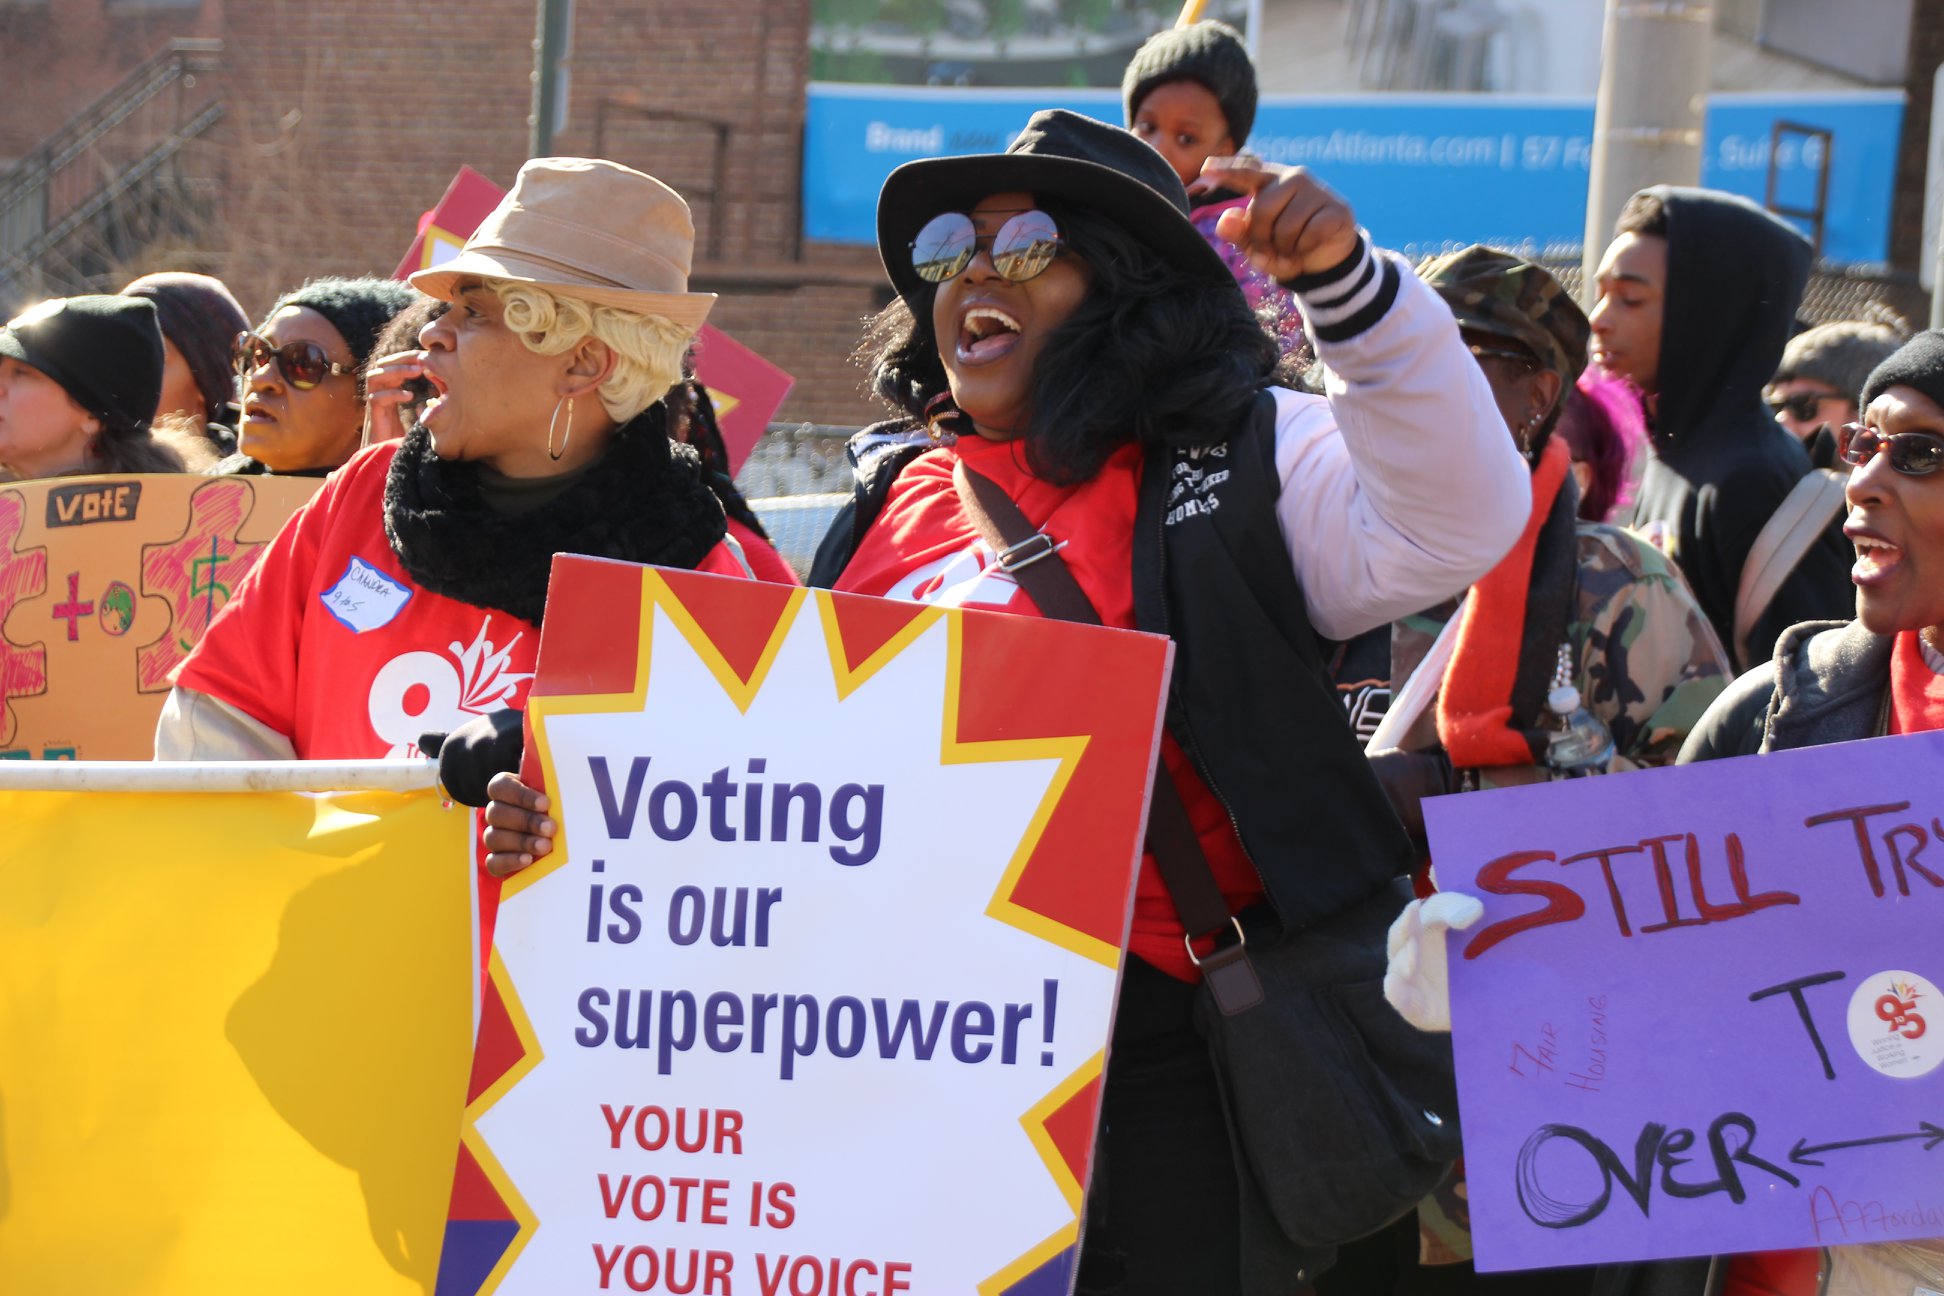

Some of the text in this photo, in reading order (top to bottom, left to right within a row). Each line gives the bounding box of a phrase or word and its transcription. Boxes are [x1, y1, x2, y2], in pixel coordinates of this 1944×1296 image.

[866, 121, 943, 152] Brand
[587, 756, 885, 867] Voting
[586, 859, 783, 948] is our
[1462, 831, 1801, 961] STILL
[574, 978, 1059, 1081] superpower!
[600, 1104, 744, 1155] YOUR
[597, 1173, 796, 1230] VOTE IS
[592, 1243, 912, 1296] YOUR VOICE
